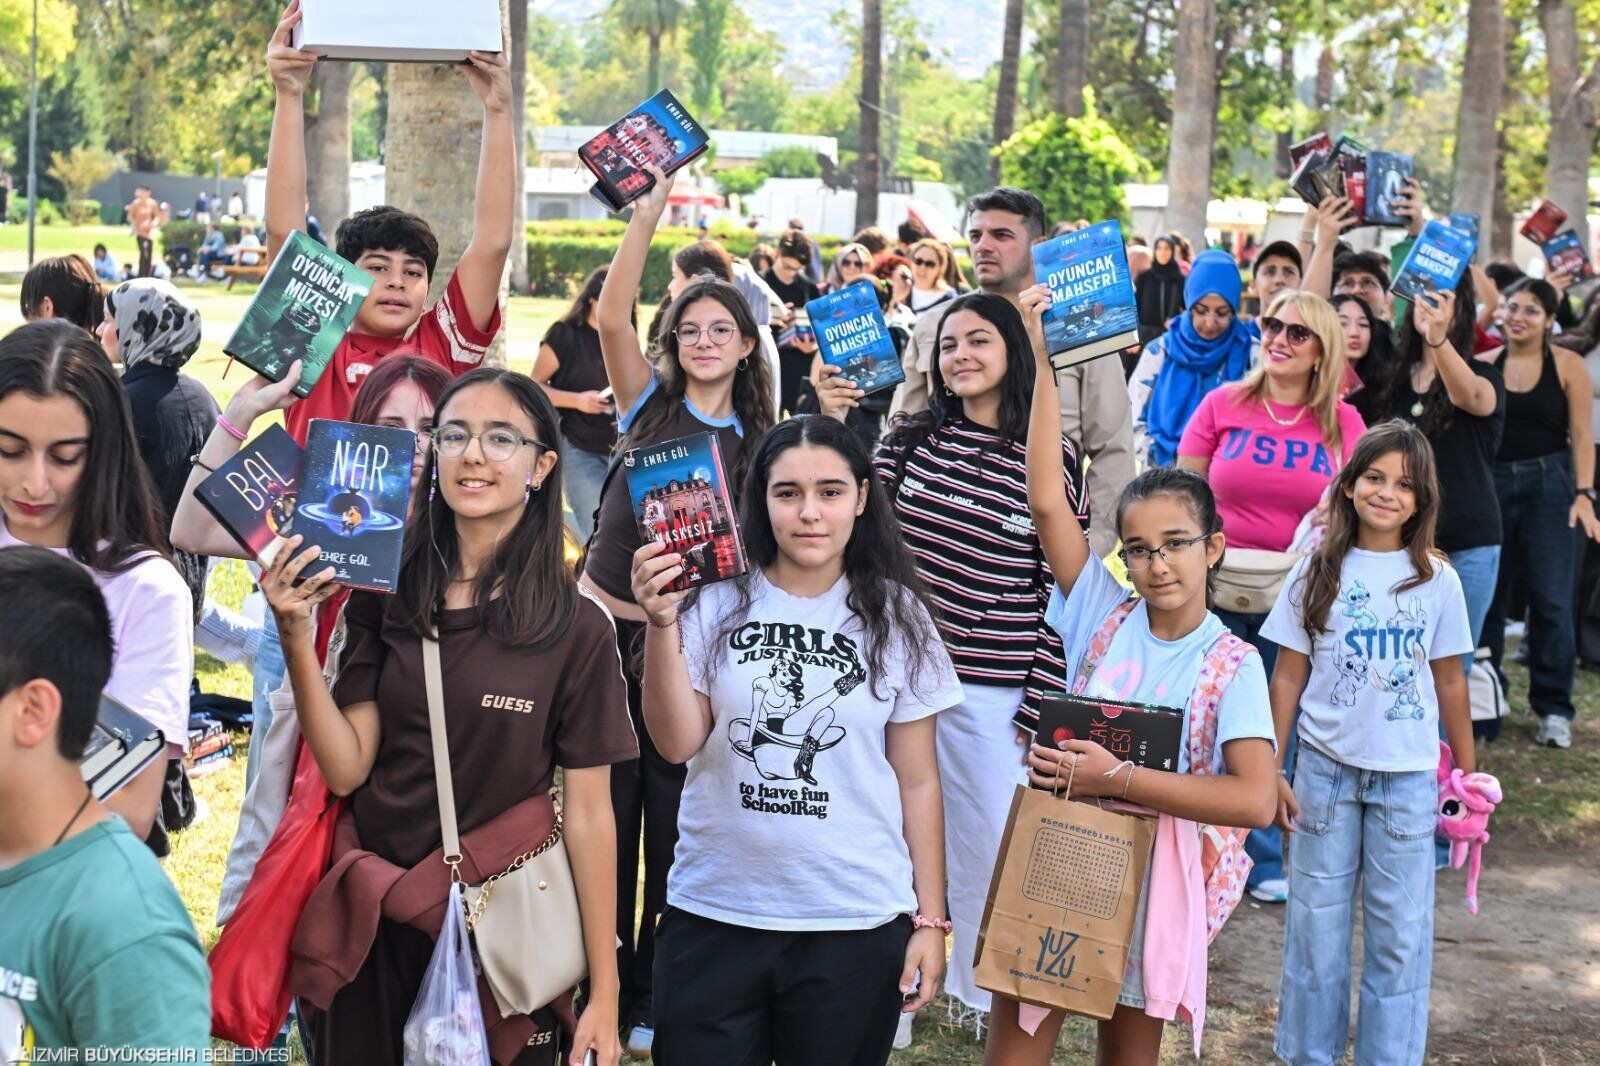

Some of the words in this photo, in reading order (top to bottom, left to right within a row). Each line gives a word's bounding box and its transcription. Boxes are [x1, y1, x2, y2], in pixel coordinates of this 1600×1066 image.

[291, 254, 355, 304] OYUNCAK
[1048, 254, 1115, 288] OYUNCAK
[825, 312, 877, 342] OYUNCAK
[330, 439, 389, 492] NAR
[643, 451, 668, 467] EMRE
[671, 445, 690, 460] GÜL
[1222, 428, 1333, 476] USPA
[225, 451, 295, 512] BAL
[319, 551, 347, 564] EMRE
[729, 620, 859, 664] GIRLS
[737, 648, 788, 665] JUST
[791, 651, 849, 673] WANT
[481, 694, 535, 713] GUESS
[739, 781, 755, 796] to
[758, 783, 798, 800] have
[801, 786, 829, 802] fun
[741, 794, 827, 819] SchoolRag
